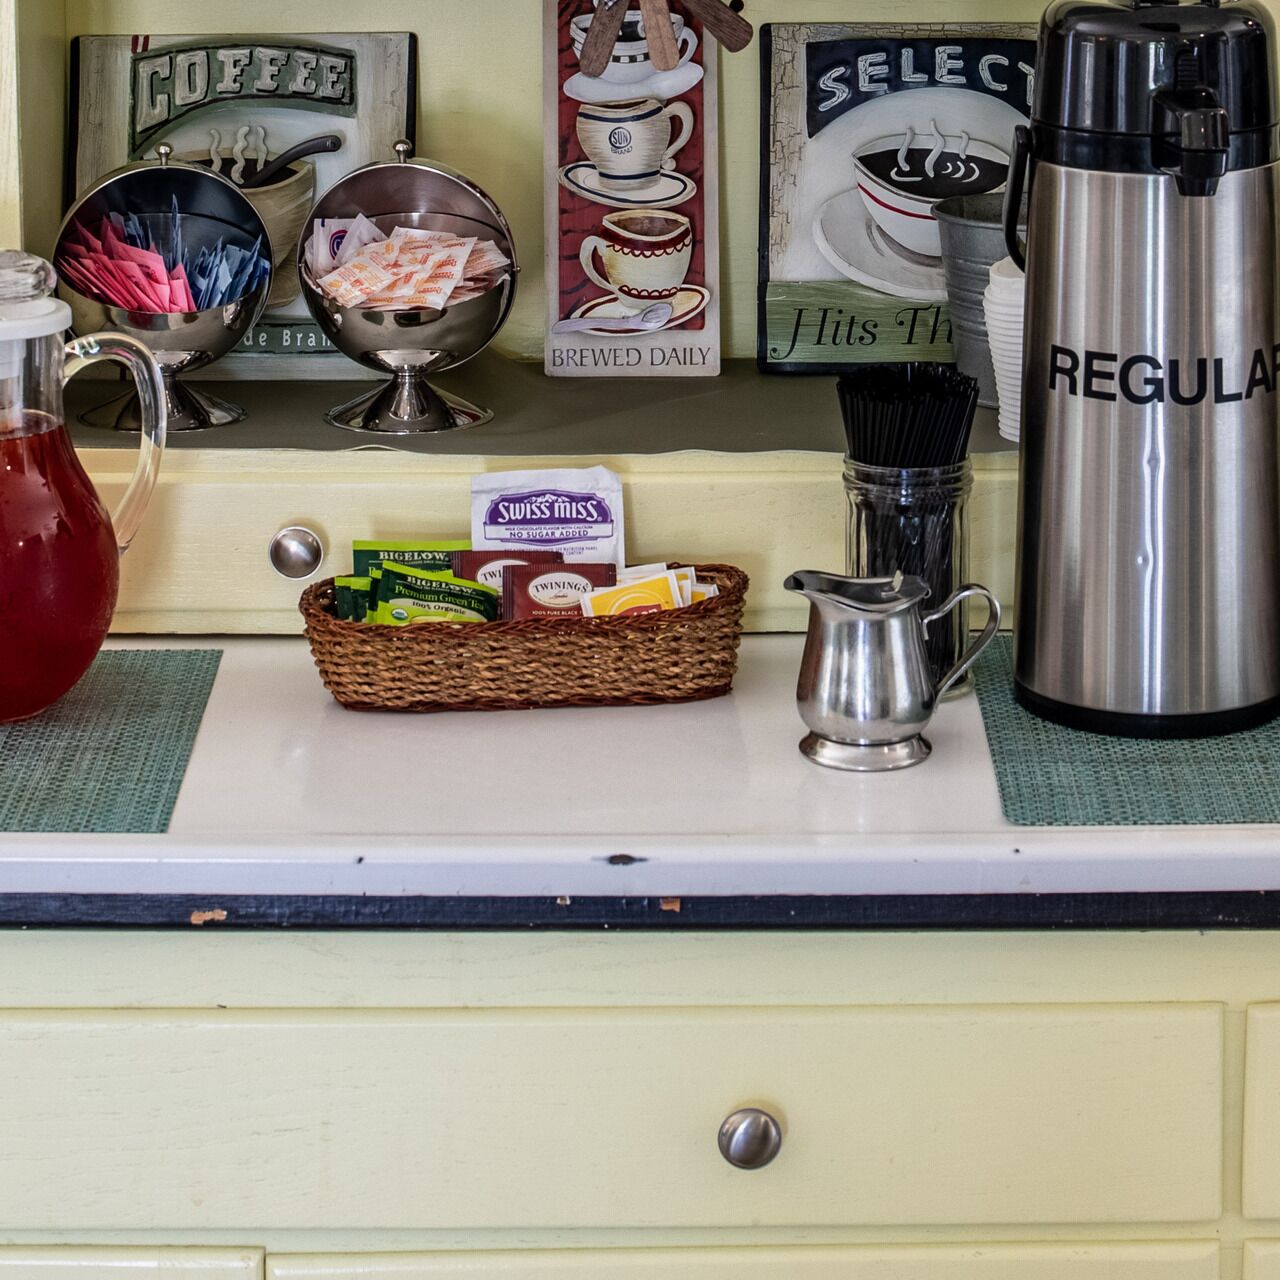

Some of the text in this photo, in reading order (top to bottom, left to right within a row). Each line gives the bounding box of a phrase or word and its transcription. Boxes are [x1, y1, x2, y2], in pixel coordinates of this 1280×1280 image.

[135, 47, 350, 135] COFFEE
[612, 130, 629, 145] SUN
[770, 307, 878, 360] Hits
[551, 346, 713, 368] BREWED DAILY
[379, 552, 448, 560] BIGELOW
[407, 576, 473, 594] BIGELOW
[532, 581, 586, 593] TWININGS
[394, 585, 439, 601] Premium
[439, 593, 468, 607] Green
[412, 601, 467, 615] 100% Organic
